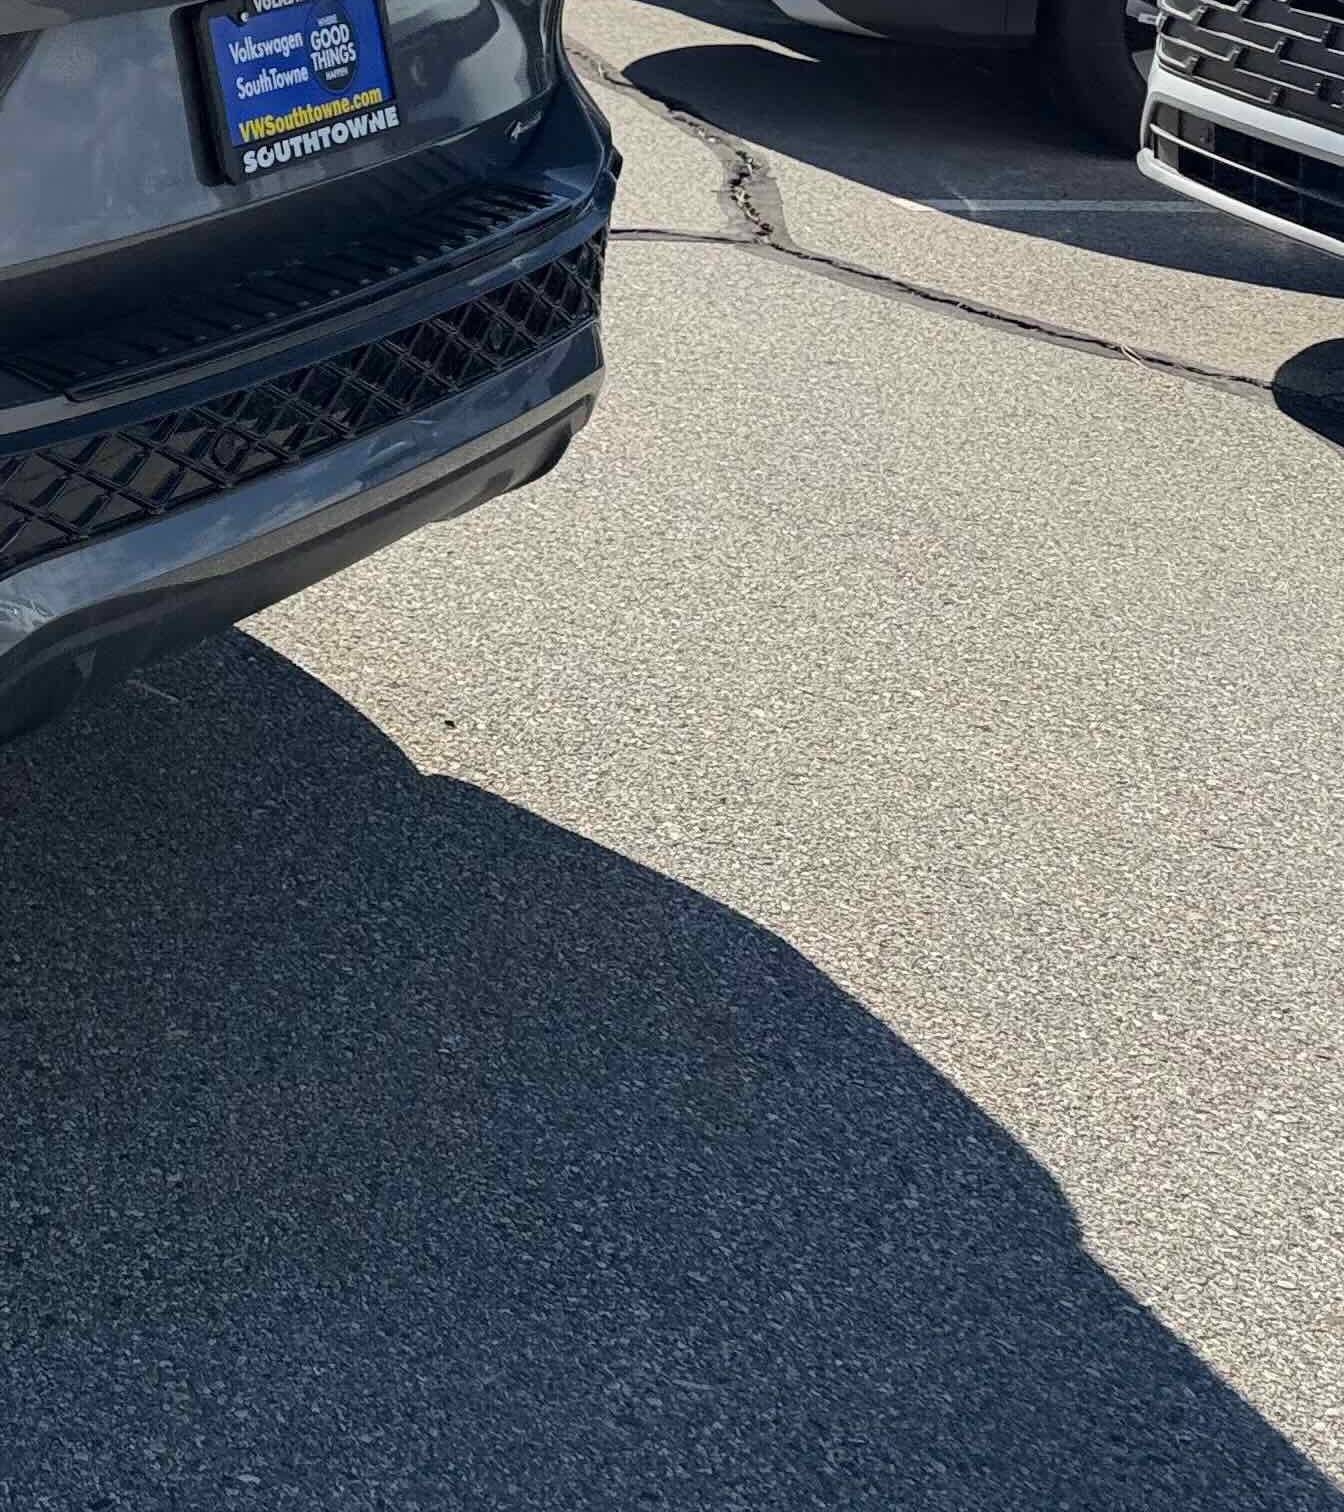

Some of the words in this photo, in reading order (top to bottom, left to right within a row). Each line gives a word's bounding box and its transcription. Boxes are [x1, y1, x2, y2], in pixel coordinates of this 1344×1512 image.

[228, 32, 304, 64] Volkswagen
[311, 23, 350, 50] GOOD
[310, 42, 357, 71] THINGS
[236, 66, 309, 99] SouthTowne
[239, 87, 382, 142] VWSouthtowne.com
[243, 105, 400, 174] SOUTHTOWNE
